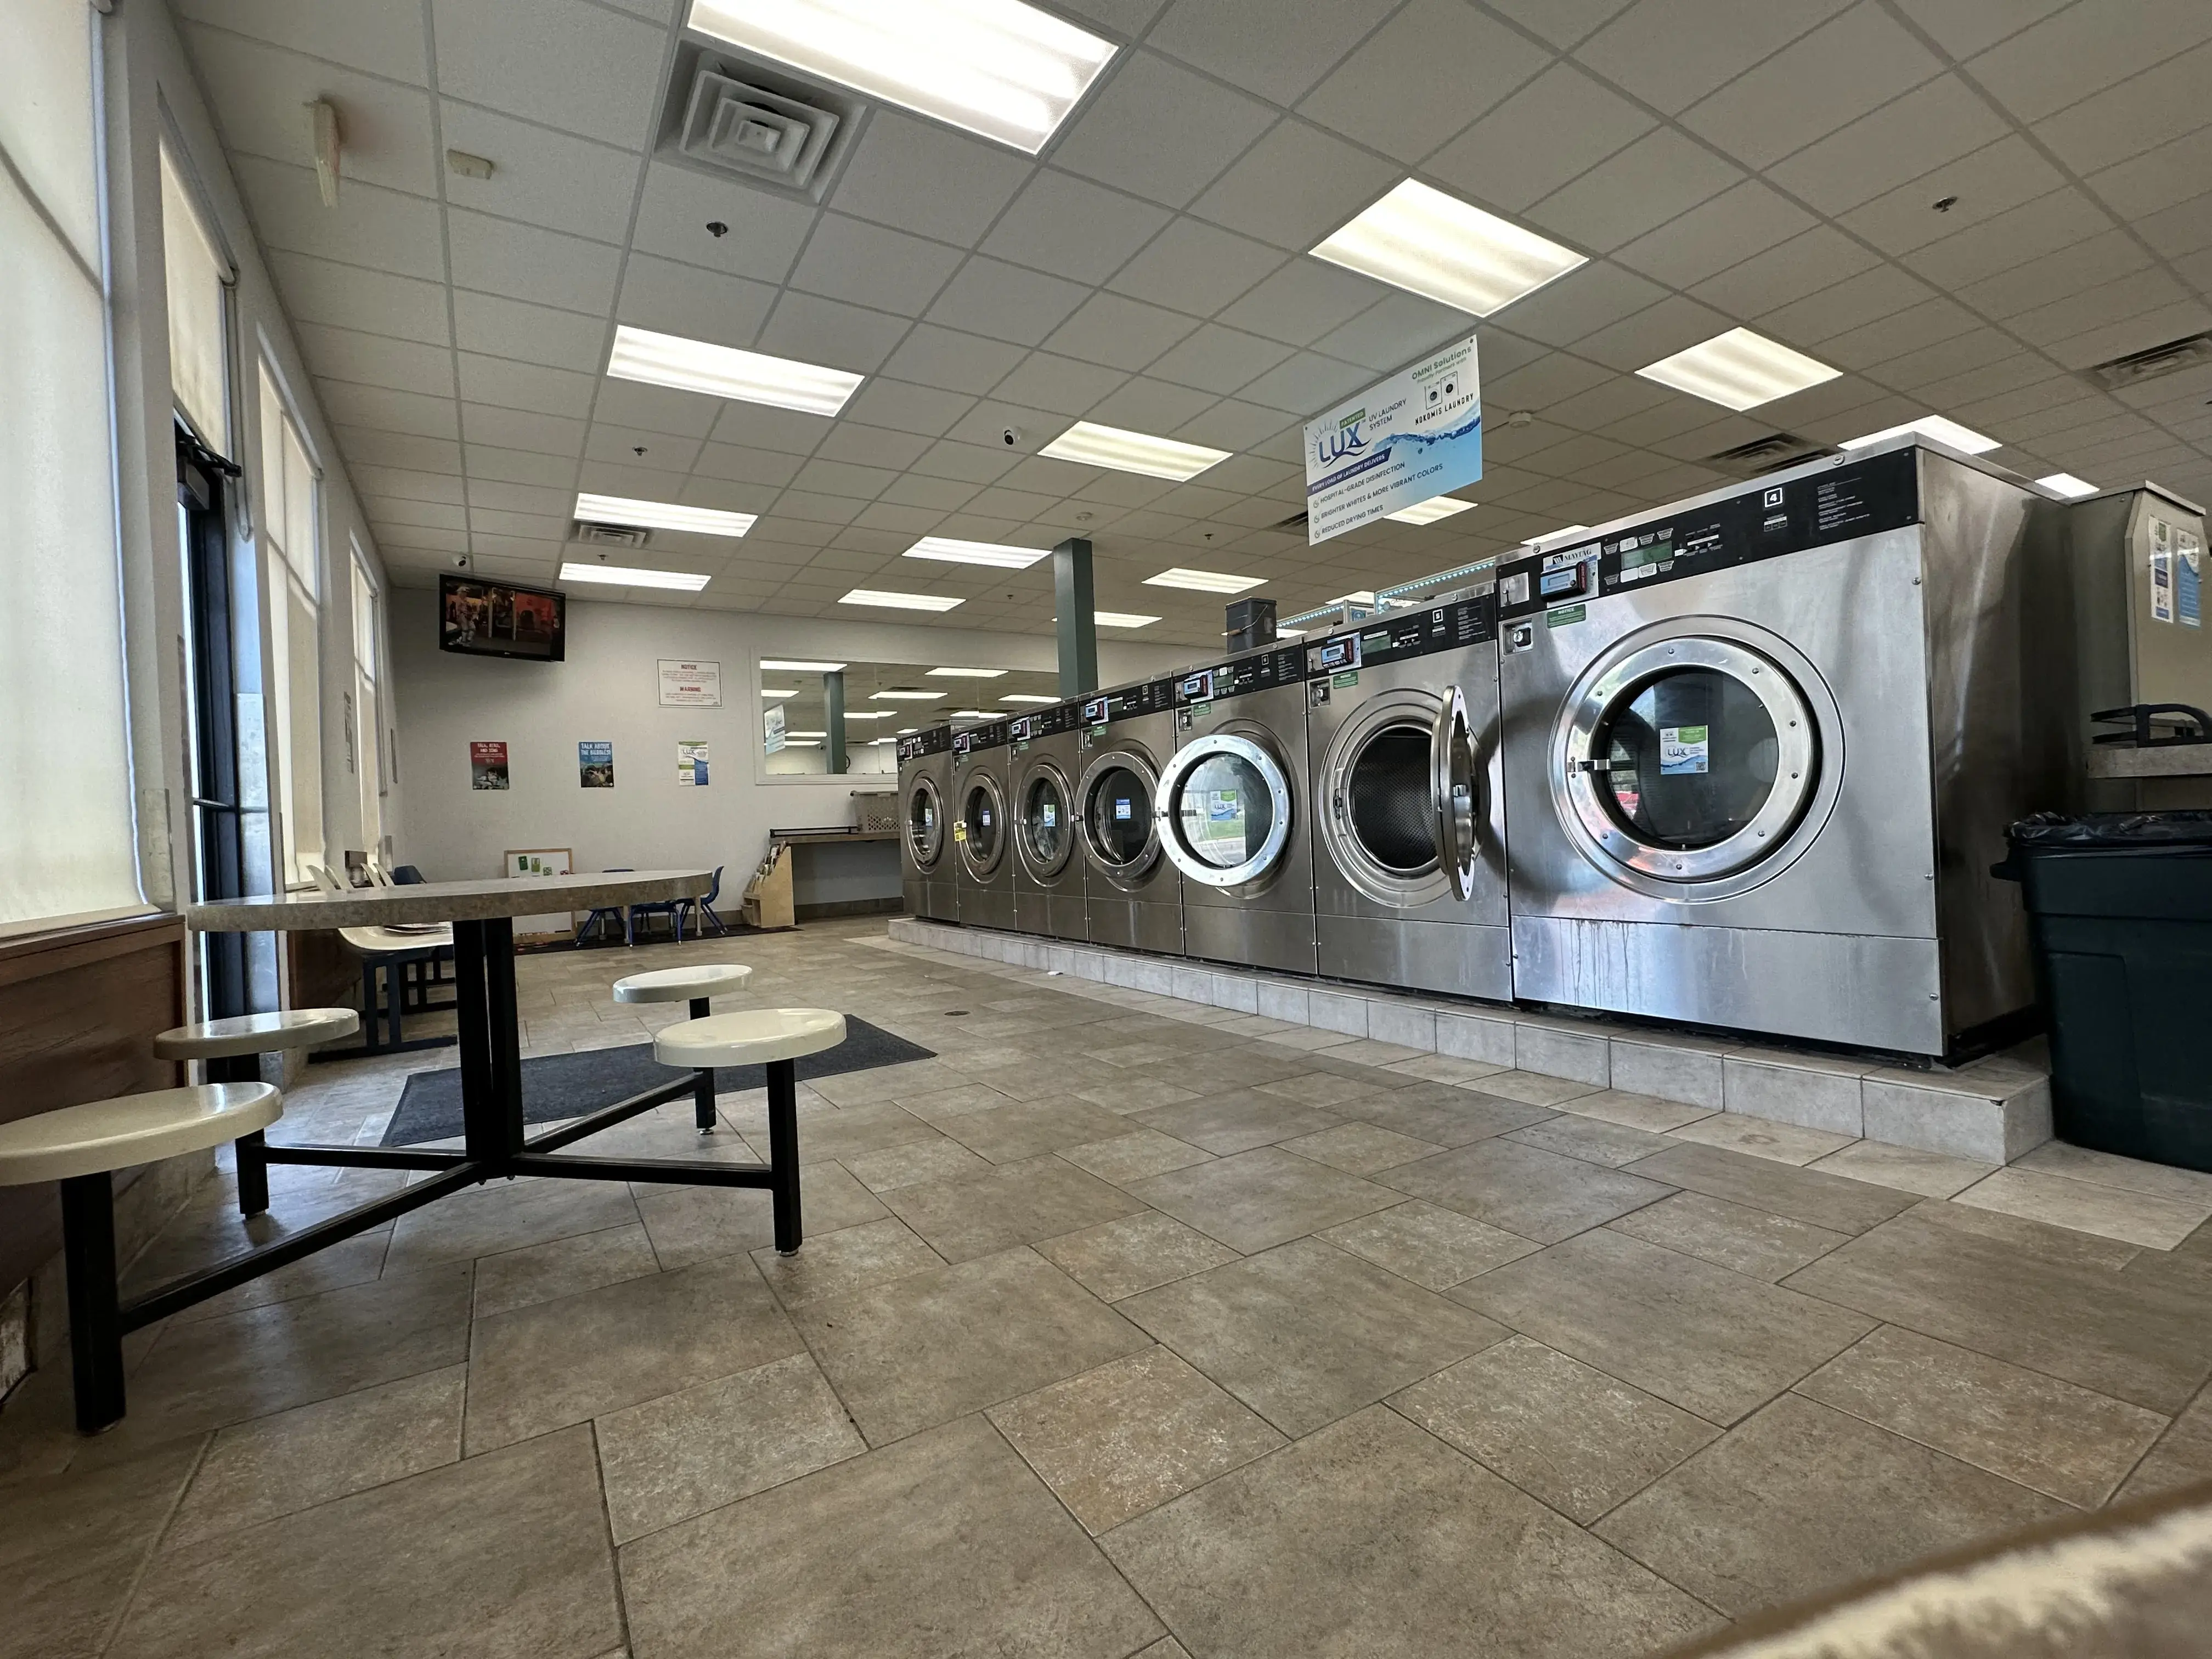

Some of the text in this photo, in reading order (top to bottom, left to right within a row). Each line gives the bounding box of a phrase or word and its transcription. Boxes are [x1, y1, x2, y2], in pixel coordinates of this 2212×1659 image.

[1412, 346, 1471, 380] OMNI Solutions
[1341, 411, 1364, 427] PATENTED
[1369, 398, 1407, 422] UV LAUNDRY
[1369, 414, 1392, 431] SYSTEM
[1415, 393, 1474, 425] NOKOMIS LAUNDRY
[1319, 421, 1365, 462] LUX
[1320, 461, 1405, 504] HOSPITAL-GRADE DISINFECTION
[1325, 476, 1336, 487] LOAD
[1343, 464, 1363, 477] LAUNDRY
[1364, 454, 1385, 468] DELIVERS
[1321, 503, 1345, 519] BRIGHTER
[1346, 494, 1366, 508] WHITES
[1373, 485, 1389, 498] MORE
[1390, 474, 1416, 490] VIBRANT
[1417, 463, 1443, 479] COLORS
[1770, 493, 1778, 501] 4
[1322, 505, 1384, 534] REDUCED DRYING TIMES
[1564, 549, 1592, 561] MAYTAG
[1668, 748, 1689, 756] LUX
